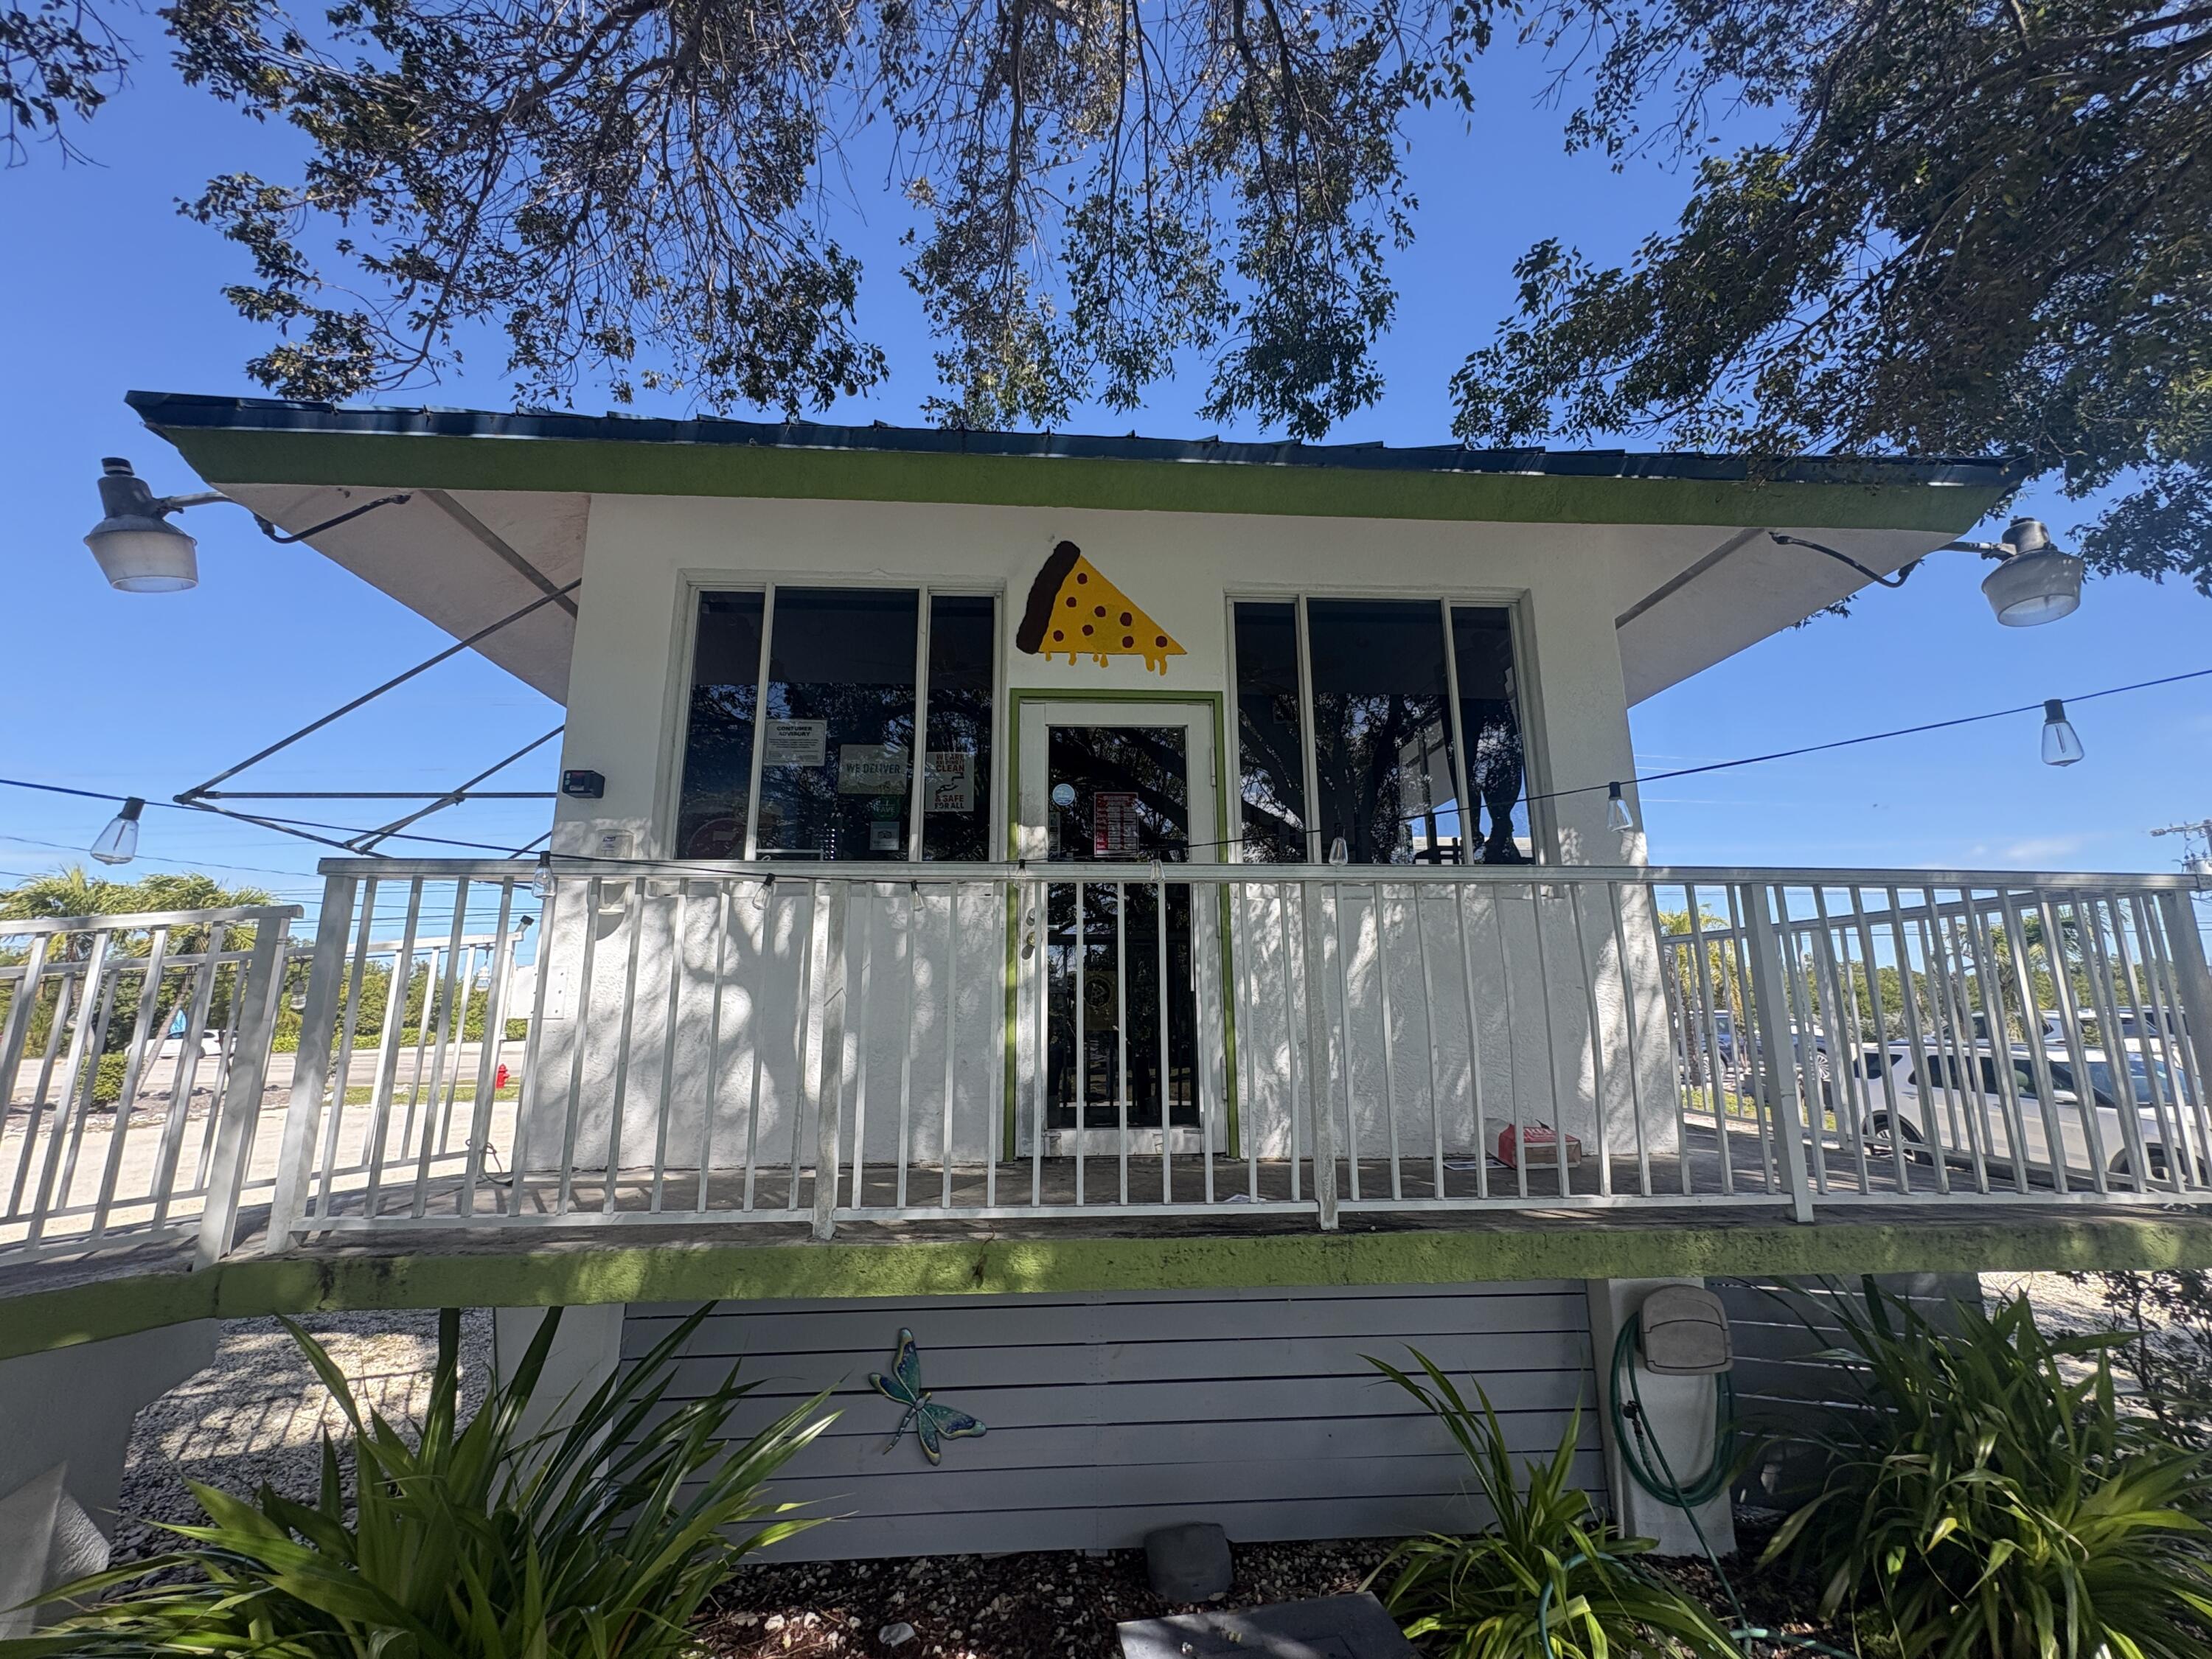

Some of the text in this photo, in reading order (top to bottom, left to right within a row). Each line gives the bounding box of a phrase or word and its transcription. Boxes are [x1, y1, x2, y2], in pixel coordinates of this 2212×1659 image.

[846, 763, 901, 774] WE DELIVER
[936, 765, 965, 773] CLEAN
[943, 794, 965, 803] SAFE
